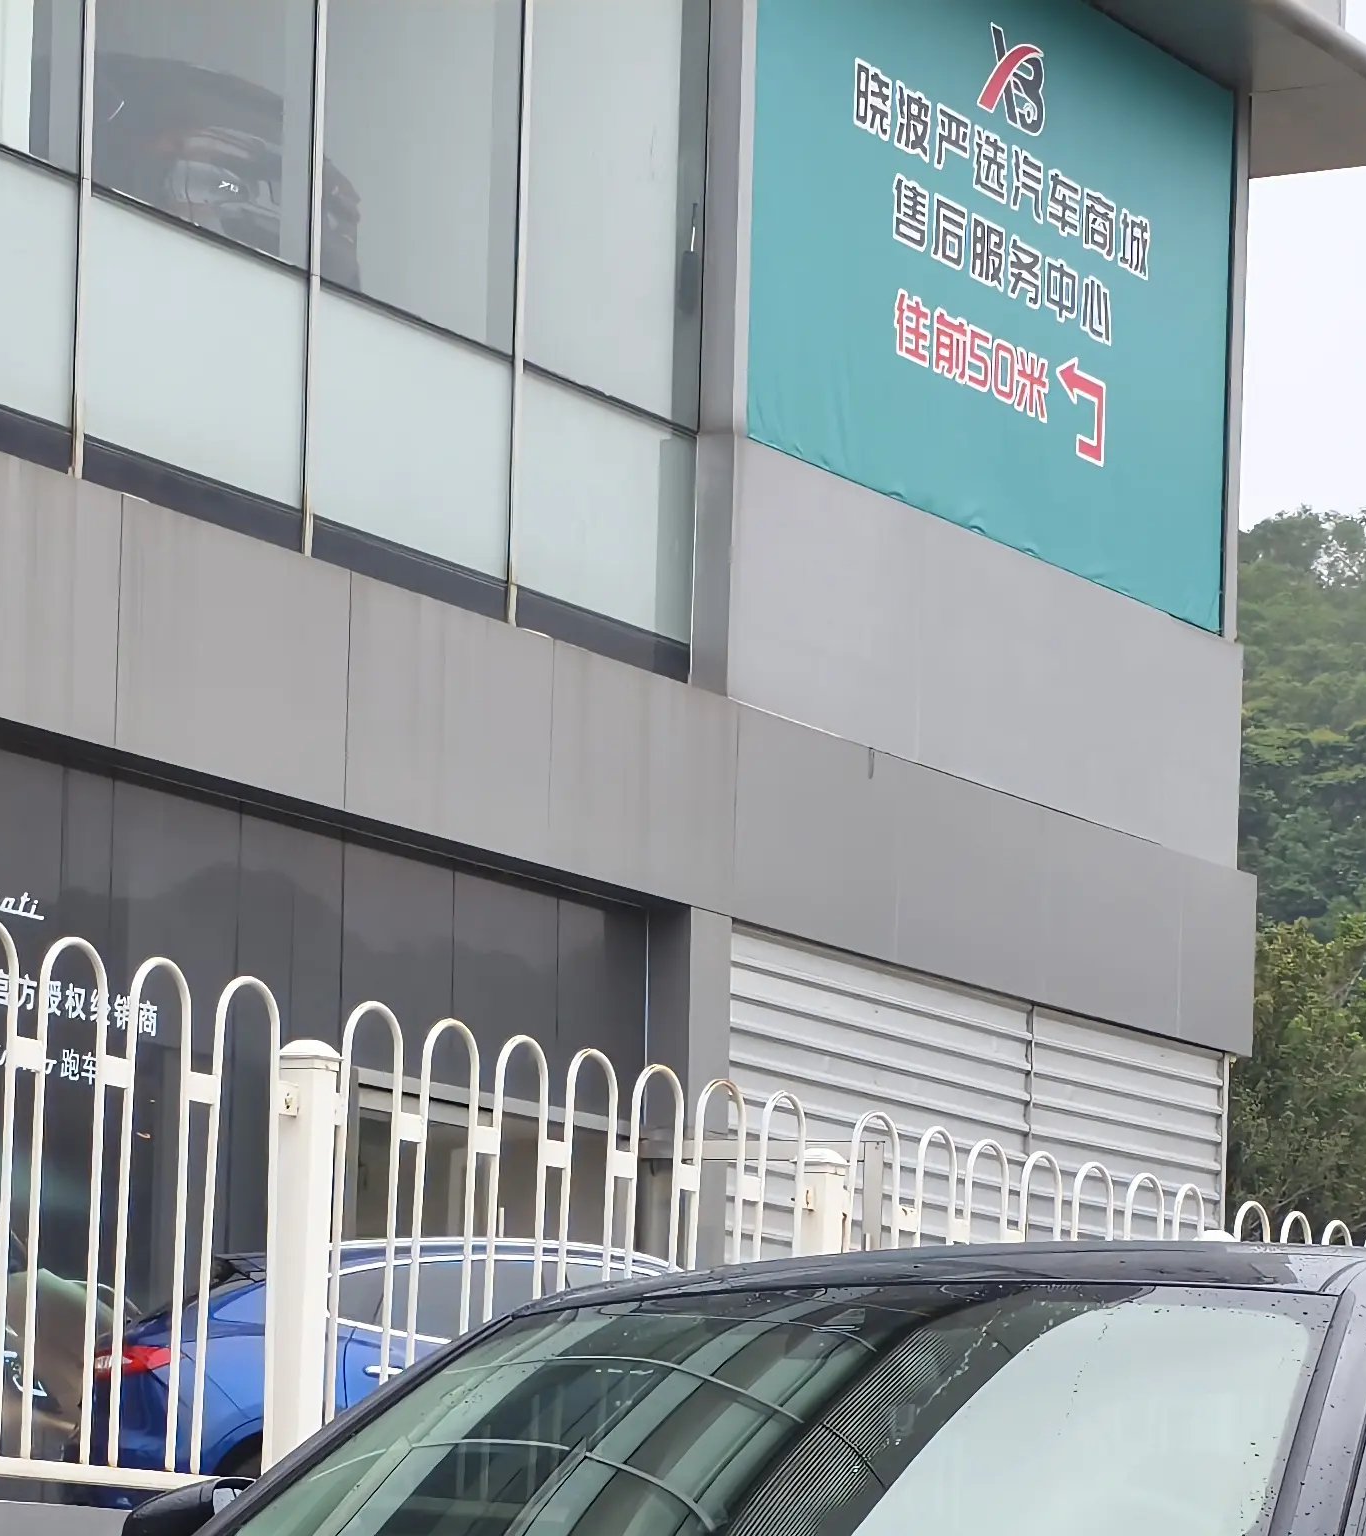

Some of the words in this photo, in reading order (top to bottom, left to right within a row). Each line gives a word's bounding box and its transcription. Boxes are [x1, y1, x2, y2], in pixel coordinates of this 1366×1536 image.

[853, 57, 1151, 281] 晓波严选汽车商城
[892, 172, 1112, 347] 售后服务中心
[893, 288, 1049, 422] 往前50米
